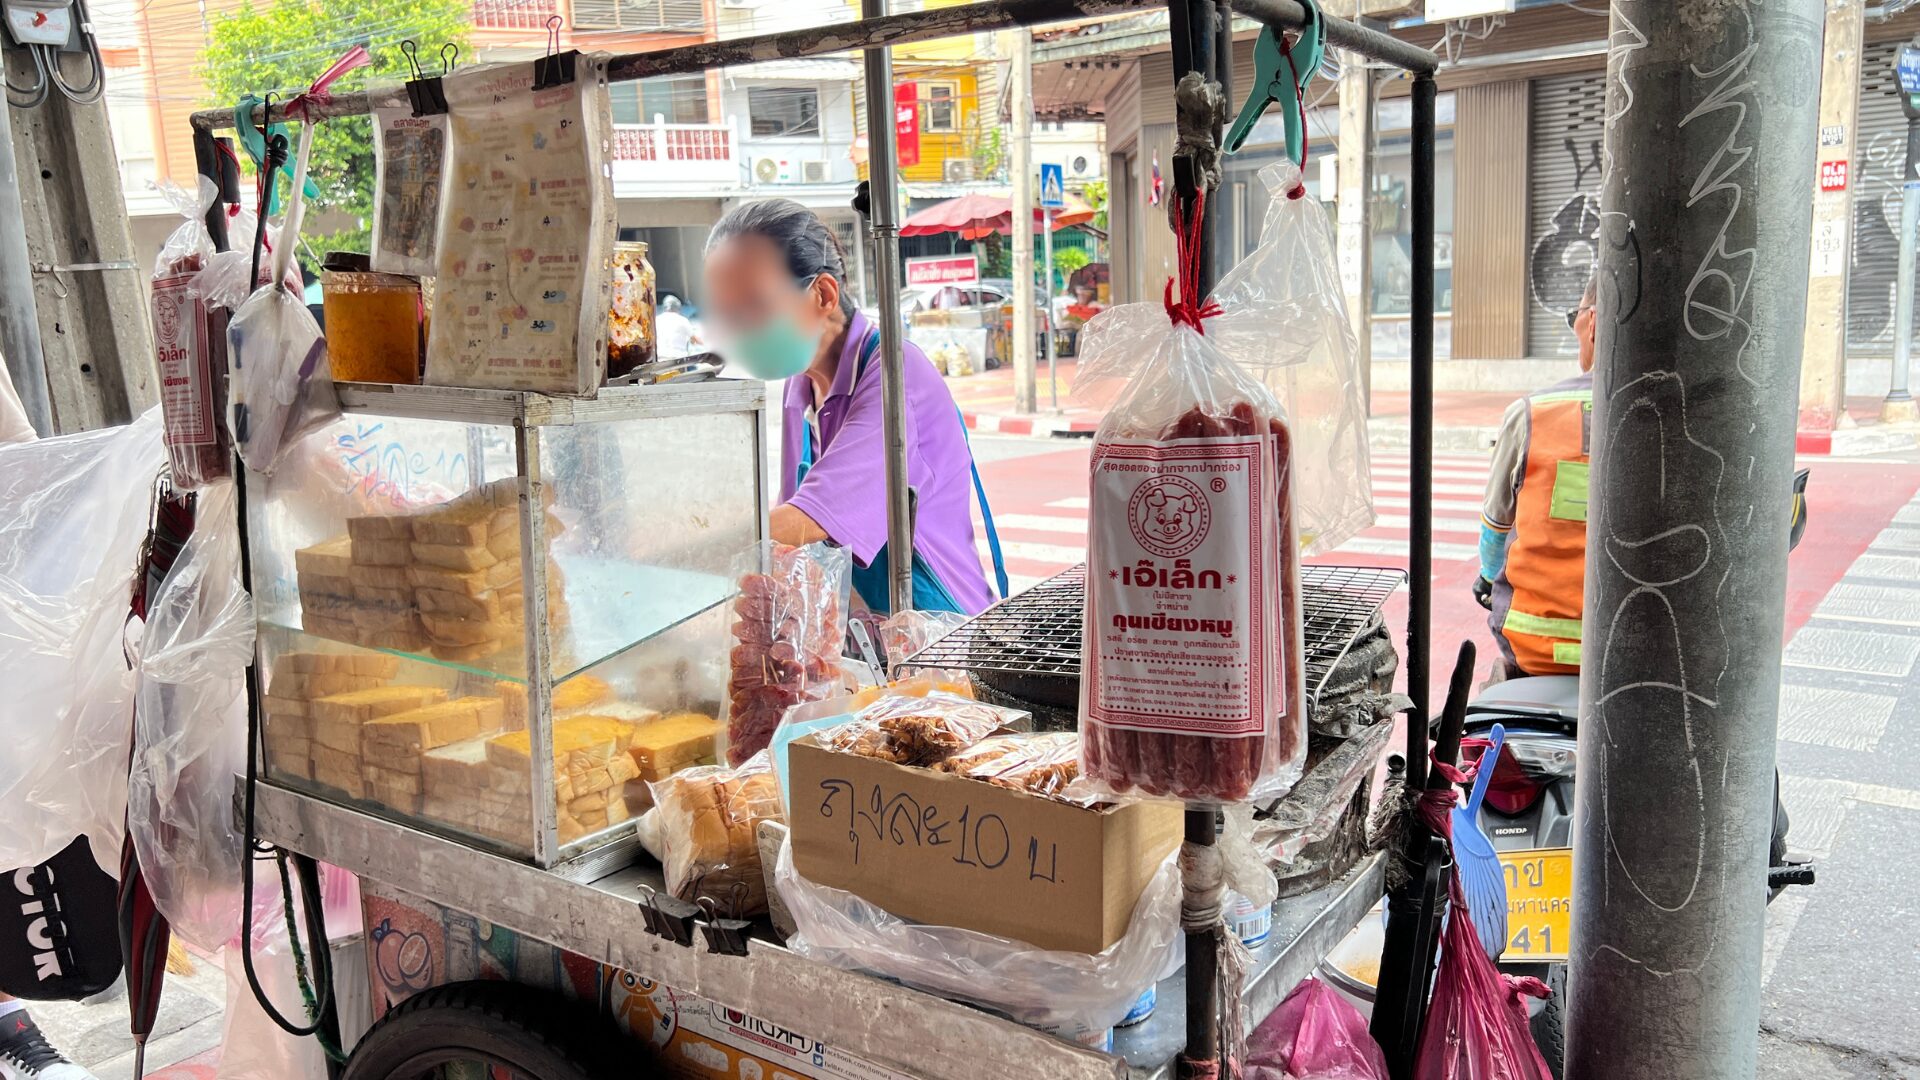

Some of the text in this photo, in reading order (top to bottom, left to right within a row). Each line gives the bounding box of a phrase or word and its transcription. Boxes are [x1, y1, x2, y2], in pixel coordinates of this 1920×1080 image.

[1156, 601, 1189, 611] จำหน่าย
[1113, 612, 1233, 638] กุนเชียงหมู
[952, 804, 1010, 869] 10
[1495, 827, 1528, 835] HONDA
[1511, 924, 1552, 954] 41
